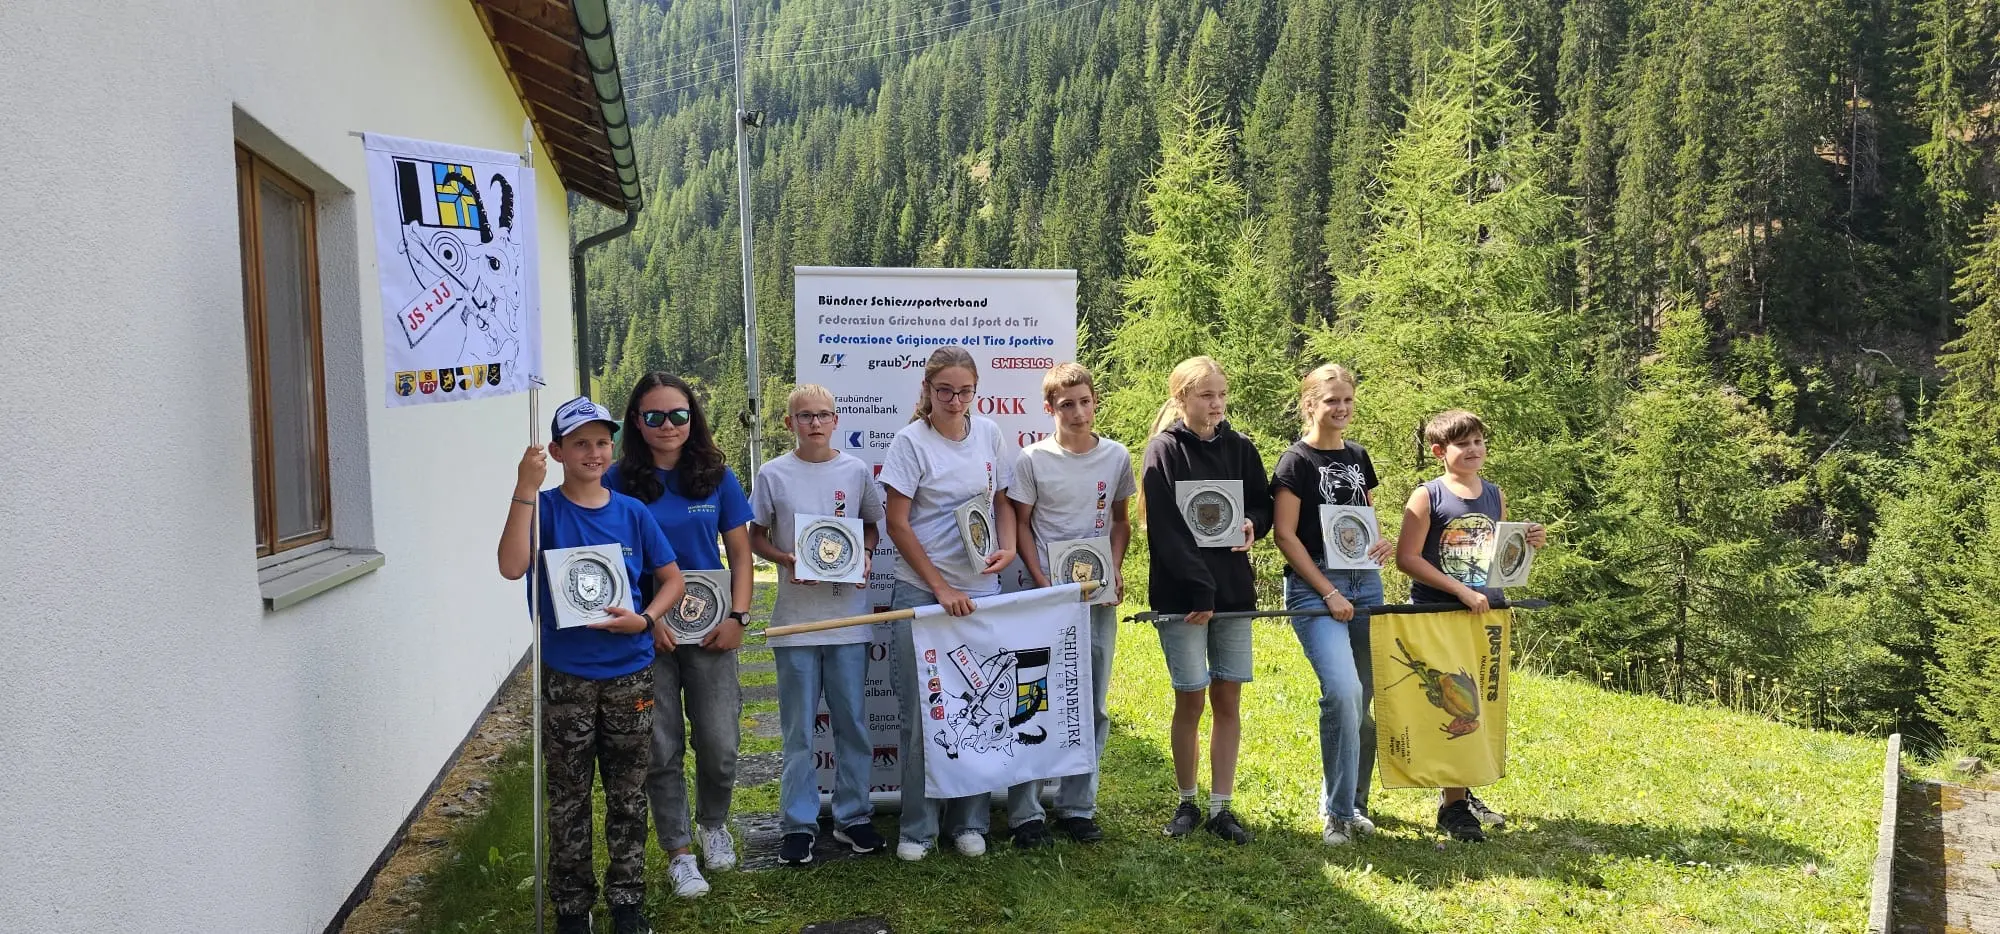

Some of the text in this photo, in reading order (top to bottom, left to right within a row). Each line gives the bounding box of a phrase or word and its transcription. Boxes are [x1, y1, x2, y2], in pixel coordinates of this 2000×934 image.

[407, 306, 425, 331] JS
[431, 281, 451, 306] JJ
[818, 295, 988, 309] Bündner Schiesssportverband
[818, 314, 1039, 329] Federaziun Grischuna dal Sport da Tir
[818, 333, 1054, 348] Federazione Grigionese del Tiro Sportivo
[820, 353, 845, 365] BSV
[991, 357, 1054, 369] SWISSLOS
[834, 394, 883, 403] raubündner
[977, 395, 1028, 415] ÖKK
[869, 430, 895, 439] Banca
[870, 572, 895, 581] Banca
[1484, 625, 1503, 702] RUSTGETS
[1064, 625, 1081, 748] SCHÜTZENBEZIRK
[869, 713, 895, 722] Banca
